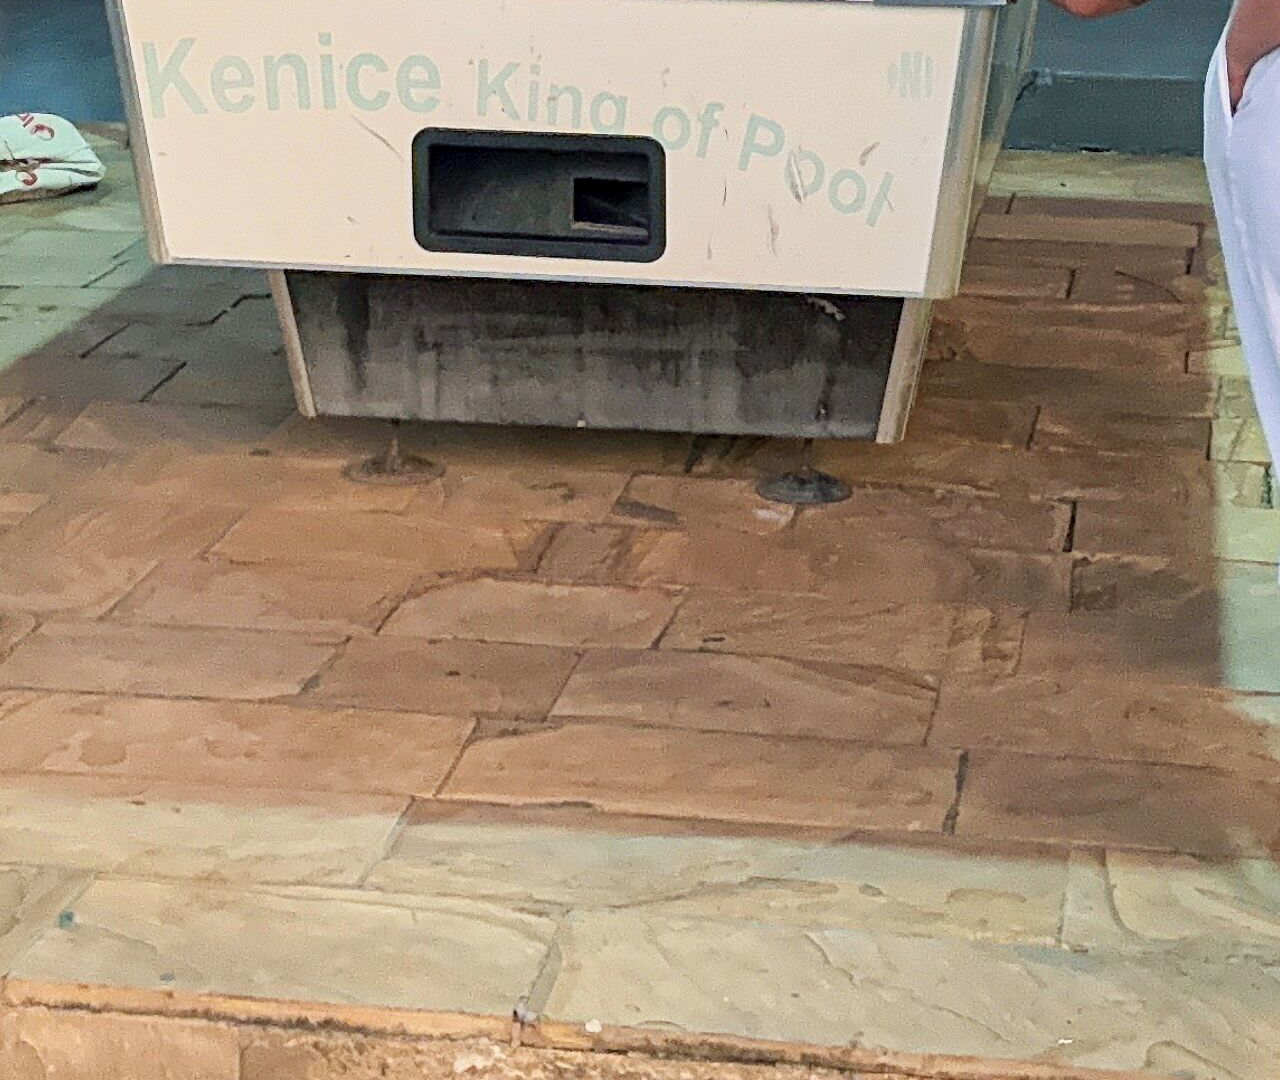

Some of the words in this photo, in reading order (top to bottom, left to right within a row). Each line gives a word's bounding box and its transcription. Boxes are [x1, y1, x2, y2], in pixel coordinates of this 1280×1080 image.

[142, 32, 441, 119] Kenice
[477, 58, 627, 134] King
[652, 101, 724, 158] of
[737, 113, 895, 228] Pool
